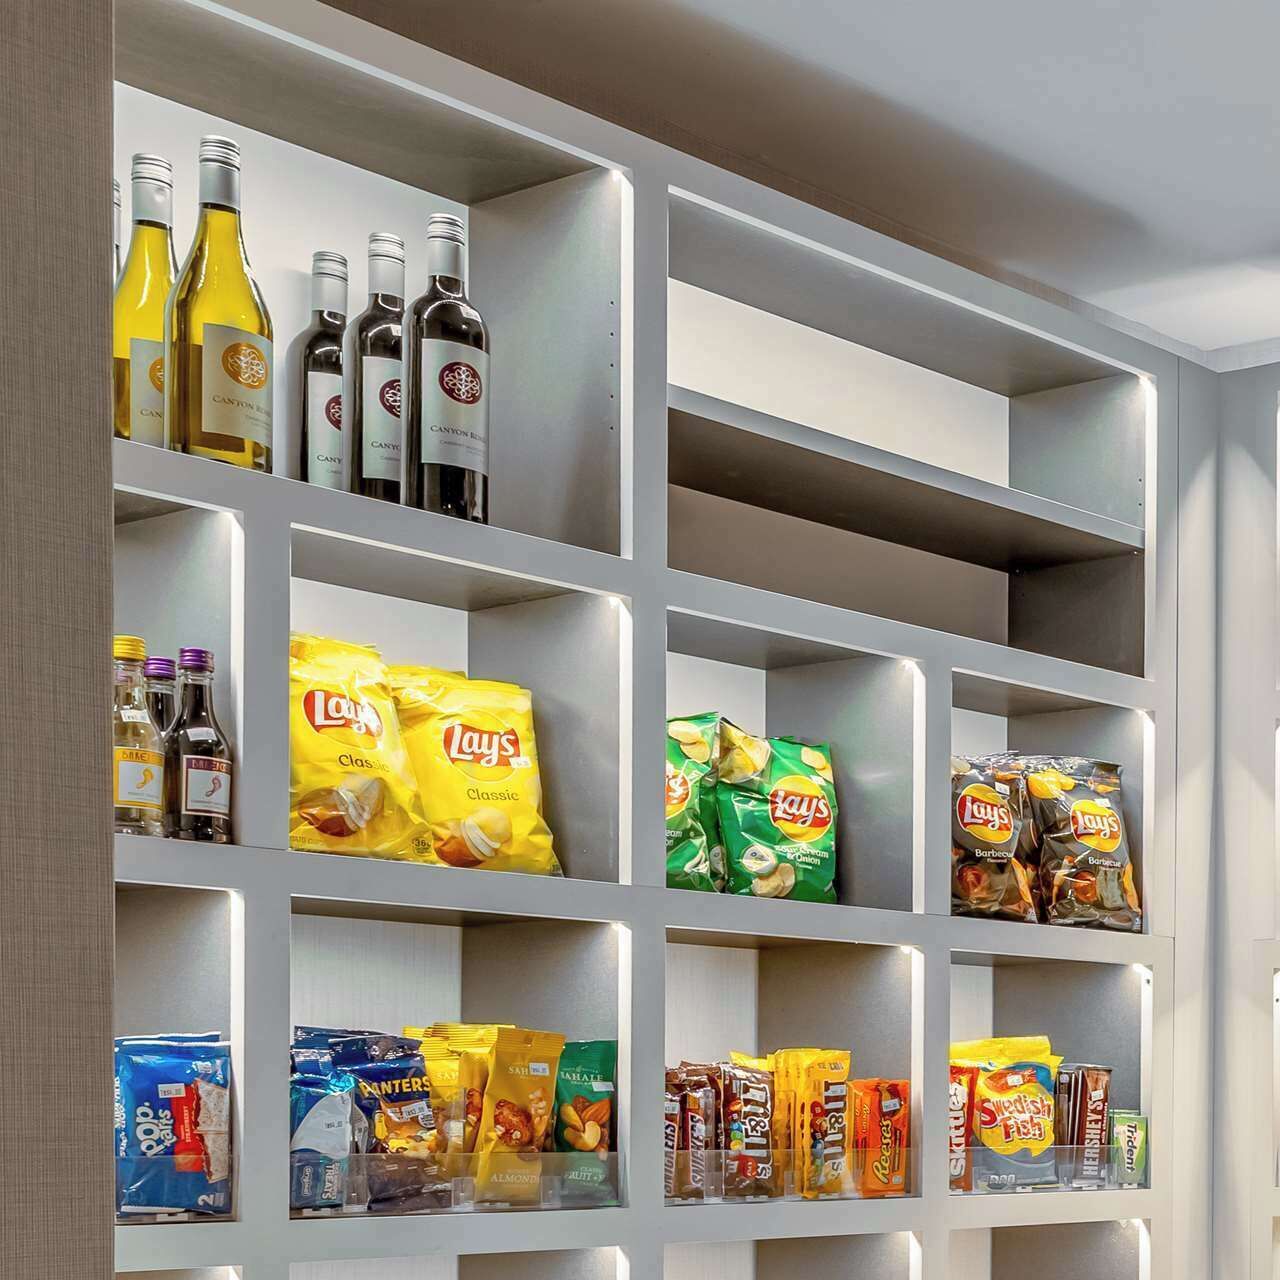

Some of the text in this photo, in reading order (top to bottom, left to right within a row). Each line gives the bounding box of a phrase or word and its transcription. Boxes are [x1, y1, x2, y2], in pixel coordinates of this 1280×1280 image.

[449, 723, 519, 766] Lay's
[467, 788, 519, 802] Classic
[775, 790, 829, 826] Lay's
[964, 796, 1008, 830] Lay's
[1076, 811, 1118, 838] Lay's
[978, 1094, 1053, 1129] Swedish
[1001, 1114, 1045, 1143] Fish
[1125, 1123, 1137, 1173] Trident
